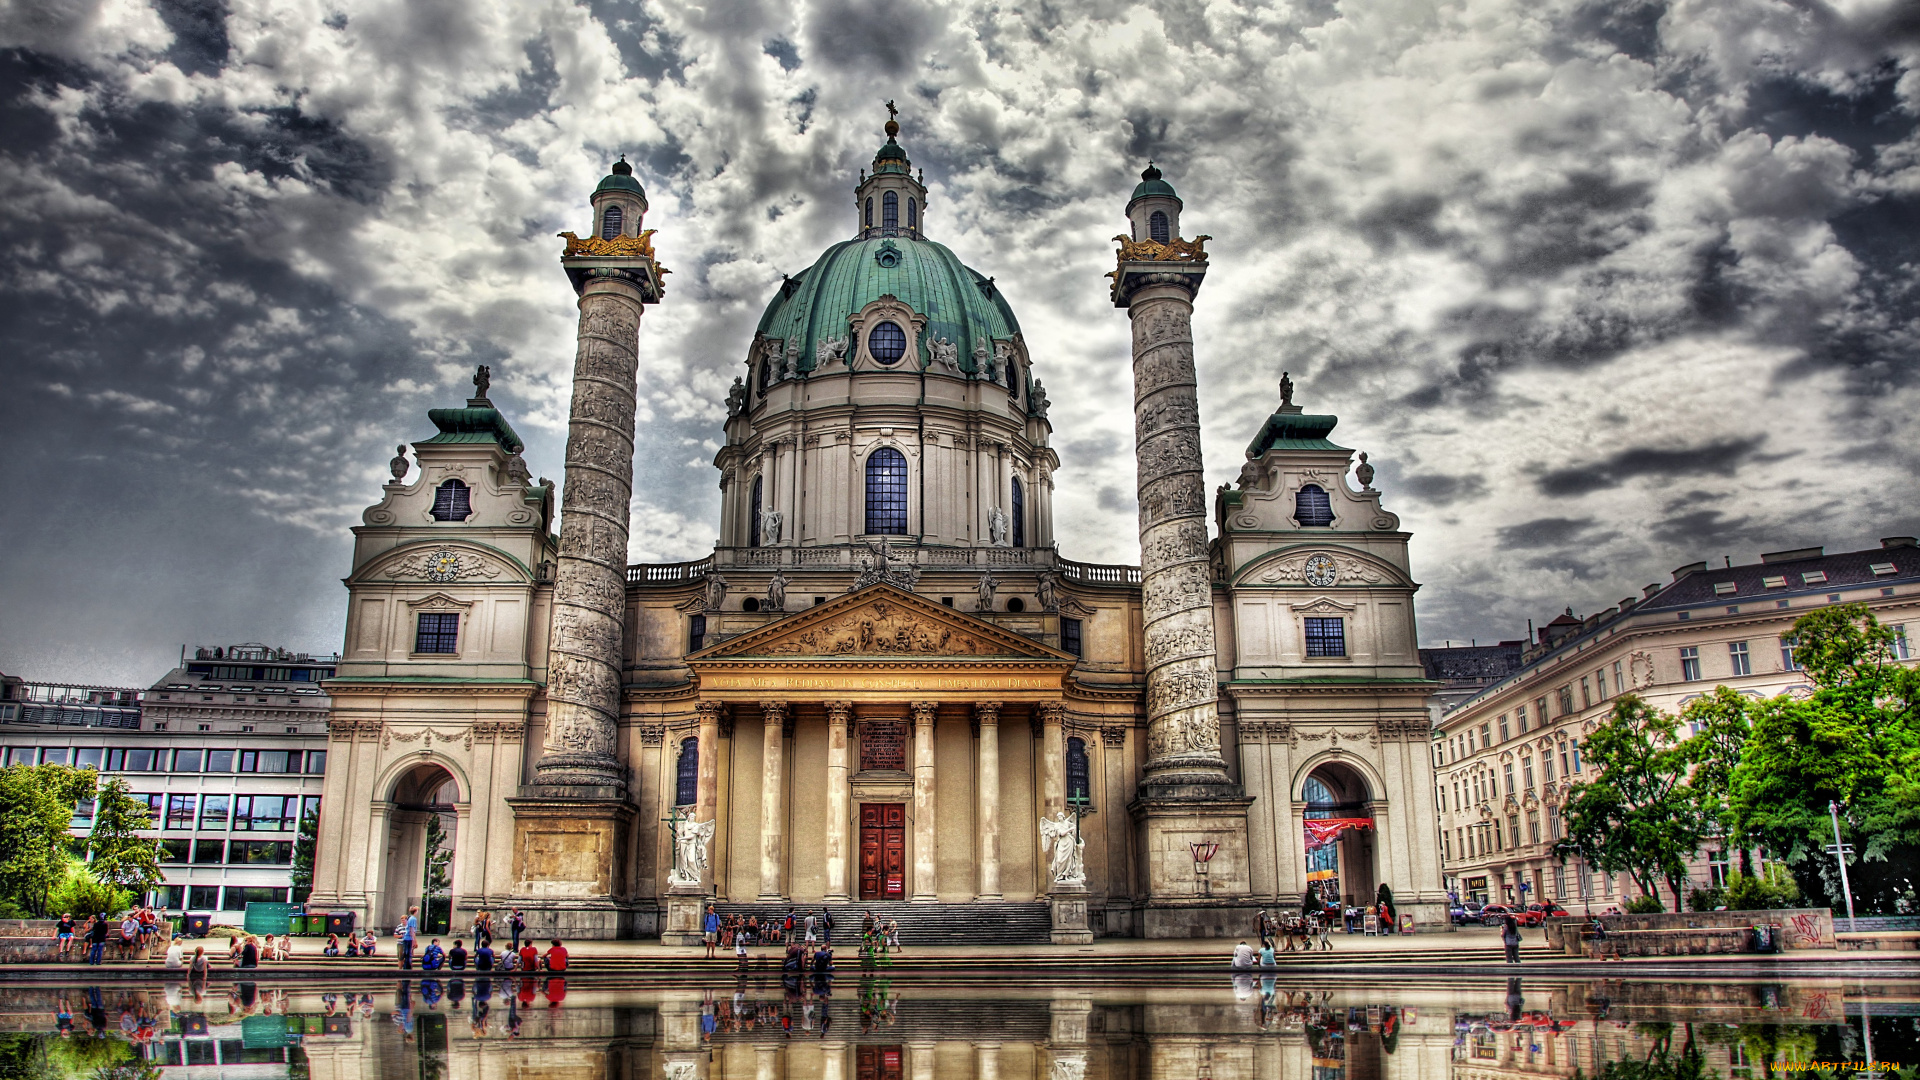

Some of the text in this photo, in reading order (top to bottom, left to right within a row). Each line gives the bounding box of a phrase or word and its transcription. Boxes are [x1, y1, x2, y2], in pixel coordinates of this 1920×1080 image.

[713, 677, 742, 687] VOTA
[751, 677, 777, 687] MEA
[786, 677, 834, 687] REDDAM
[842, 677, 854, 687] IN
